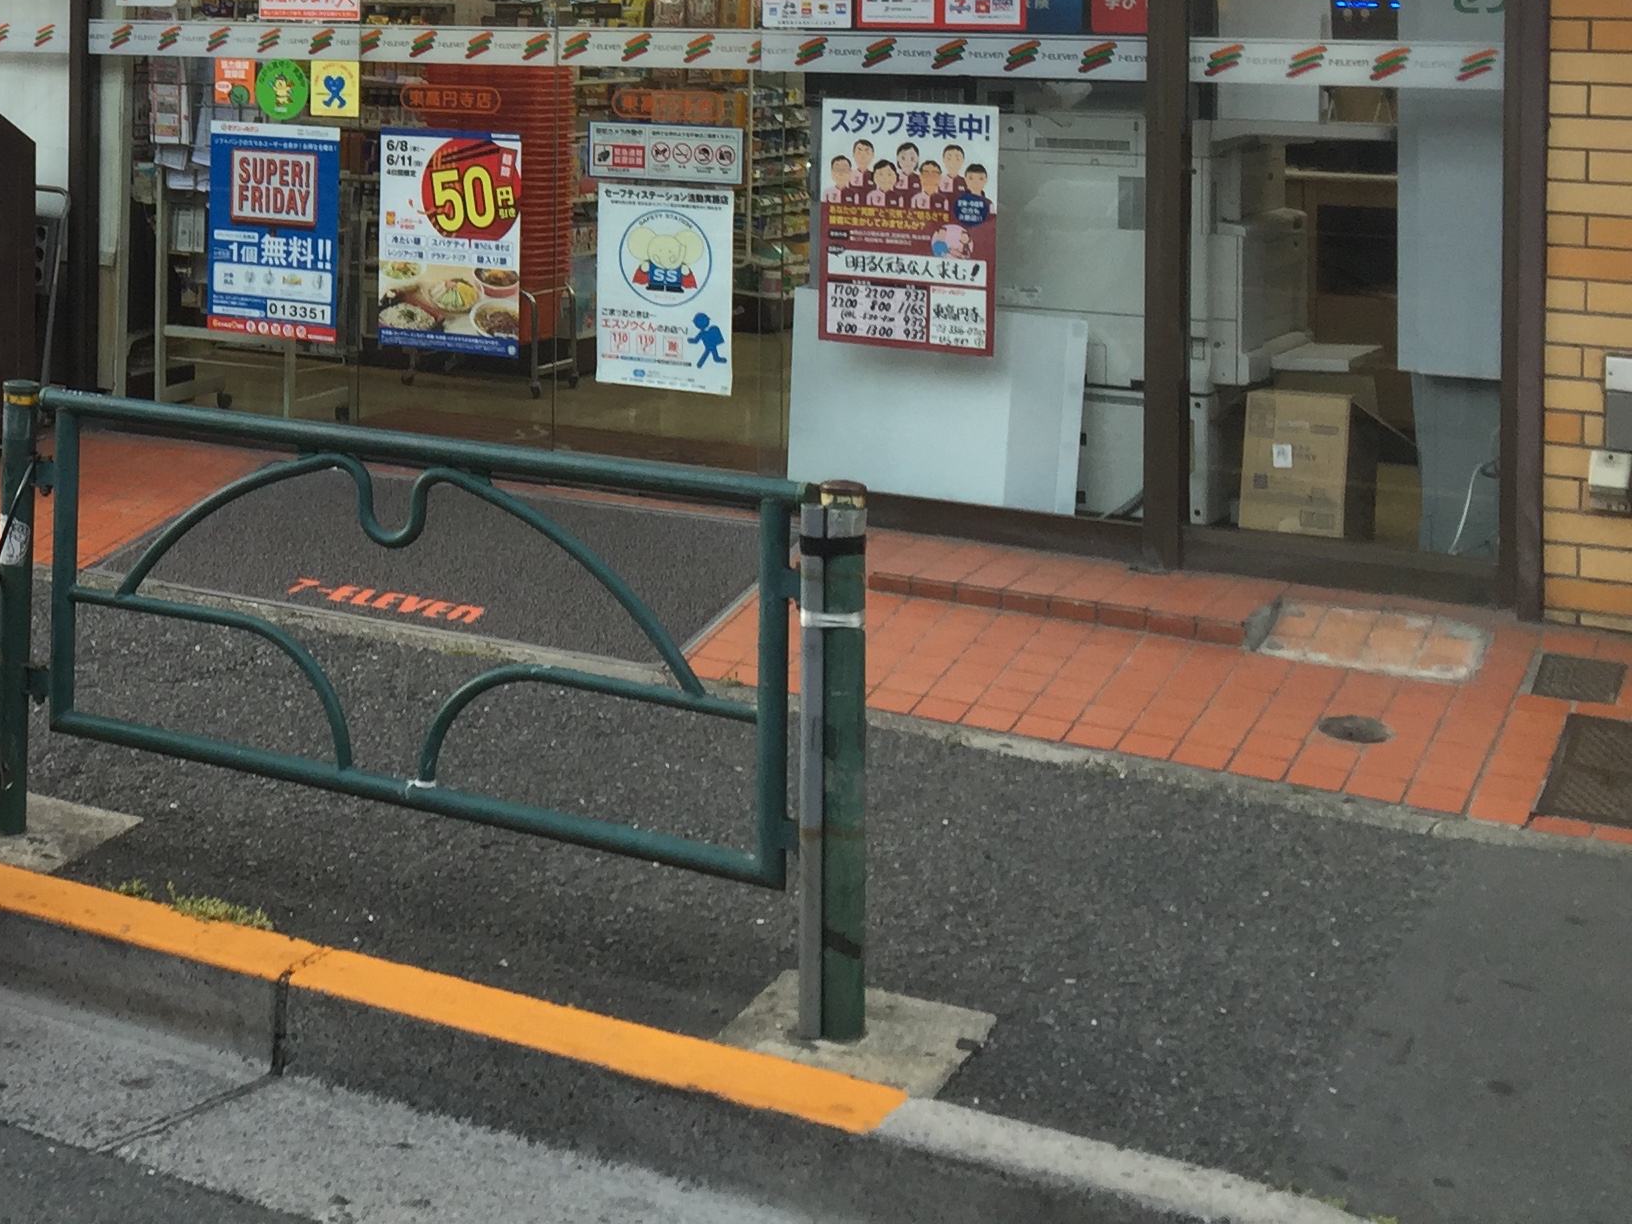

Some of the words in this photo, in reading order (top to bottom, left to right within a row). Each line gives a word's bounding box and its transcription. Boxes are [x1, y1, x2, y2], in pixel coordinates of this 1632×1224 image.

[410, 89, 492, 109] 東高円寺店
[831, 108, 991, 142] スタッフ募集中!
[238, 156, 311, 189] SUPER!
[238, 184, 311, 217] FRIDAY
[653, 268, 678, 282] SS
[269, 303, 325, 321] 013351
[612, 331, 628, 343] 110
[638, 334, 654, 345] 119
